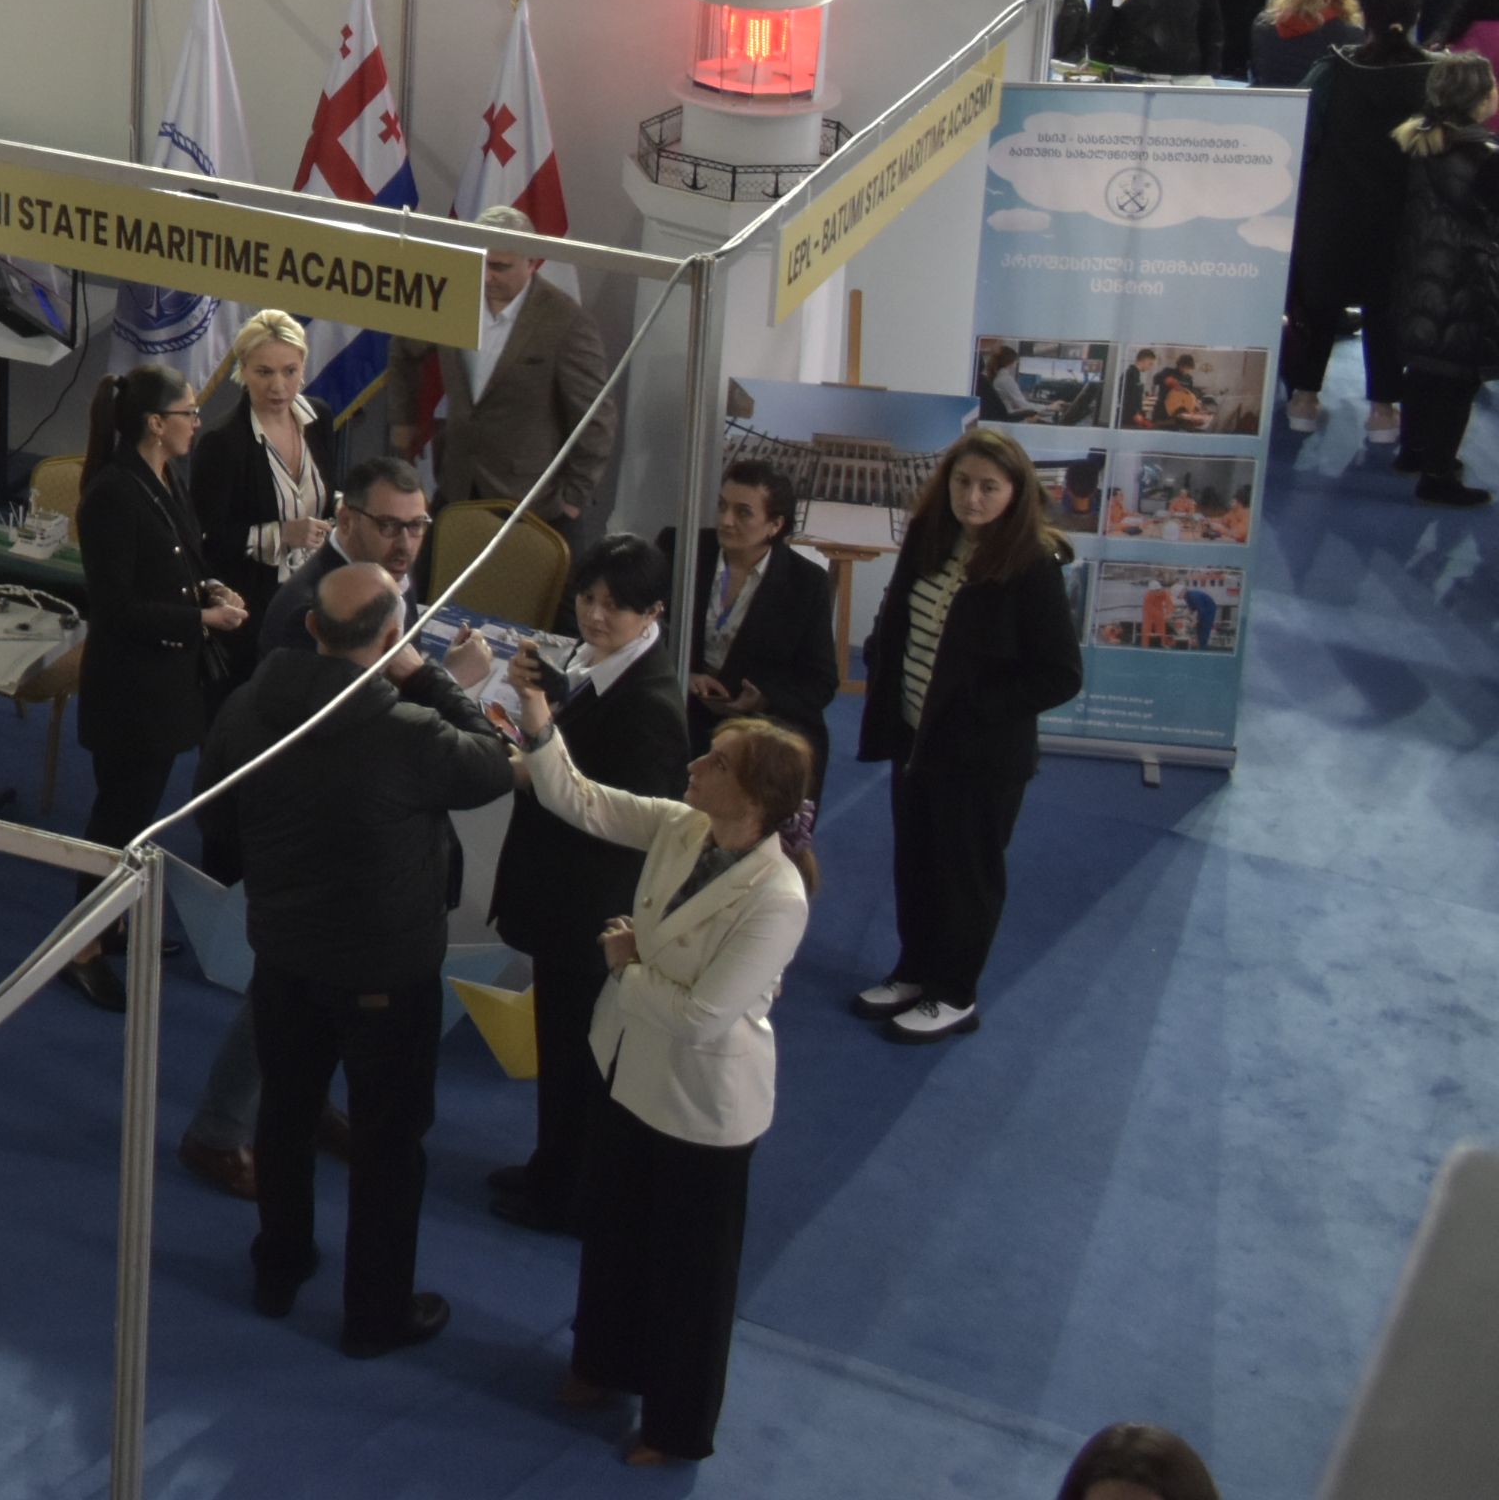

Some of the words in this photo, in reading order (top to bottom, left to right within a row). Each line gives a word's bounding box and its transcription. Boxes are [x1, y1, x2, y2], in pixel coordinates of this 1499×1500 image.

[1037, 133, 1066, 144] სსიპ
[1077, 134, 1143, 146] სასწავლო
[1147, 136, 1239, 149] უნივერსიტეტი
[1009, 147, 1062, 159] ბათუმის
[1066, 148, 1149, 162] სახელმწიფო
[1152, 151, 1209, 164] საზღვაო
[1212, 154, 1273, 166] აკადემია
[787, 234, 811, 286] LEPL
[822, 187, 865, 255] BATUMI
[865, 158, 898, 215] STATE
[898, 115, 947, 184] MARITIME
[947, 72, 996, 143] ACADEMY
[18, 195, 109, 245] STATE
[115, 216, 270, 279] MARITIME
[276, 251, 448, 312] ACADEMY
[1001, 252, 1134, 273] პროფესიული
[1140, 260, 1259, 278] მომზადების
[1090, 277, 1164, 296] ცენტრი
